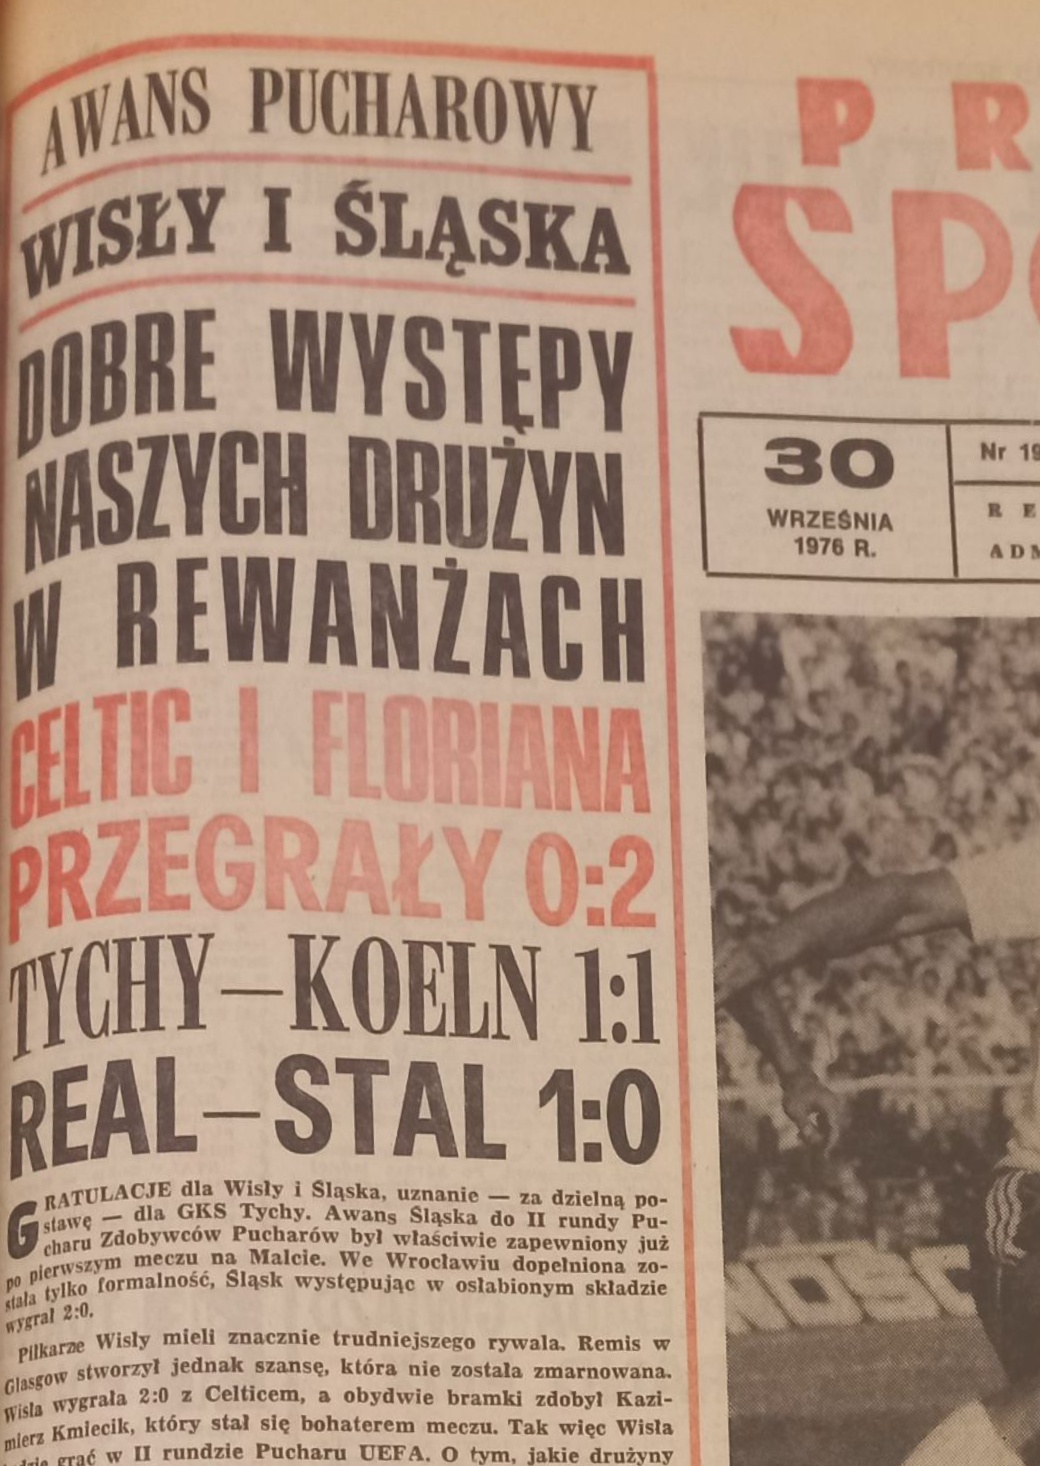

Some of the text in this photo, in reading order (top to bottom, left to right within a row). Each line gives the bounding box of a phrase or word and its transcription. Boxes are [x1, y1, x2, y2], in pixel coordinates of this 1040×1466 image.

[42, 67, 597, 177] AWANS PUCHAROWY
[19, 180, 631, 299] WISŁY I ŚLĄSKA
[17, 309, 632, 466] DOBRE WYSTĘPY
[25, 430, 625, 574] NASZYCH DRUŻYN
[765, 437, 894, 489] 30
[981, 442, 1006, 460] Nr
[767, 508, 893, 531] WRZEŚNIA
[794, 537, 844, 556] 1976
[13, 556, 645, 702] W REWANŻACH
[10, 688, 651, 828] CELTIC I FLORIANA
[8, 813, 656, 945] PRZEGRAŁY 0:2
[575, 948, 660, 1044] 1:1
[539, 1069, 661, 1165] 1:0
[181, 1180, 213, 1196] dla
[224, 1180, 283, 1199] Wisły
[295, 1181, 301, 1197] i
[398, 1187, 478, 1203] uznanie
[520, 1193, 542, 1205] za
[552, 1189, 625, 1210] dzielną
